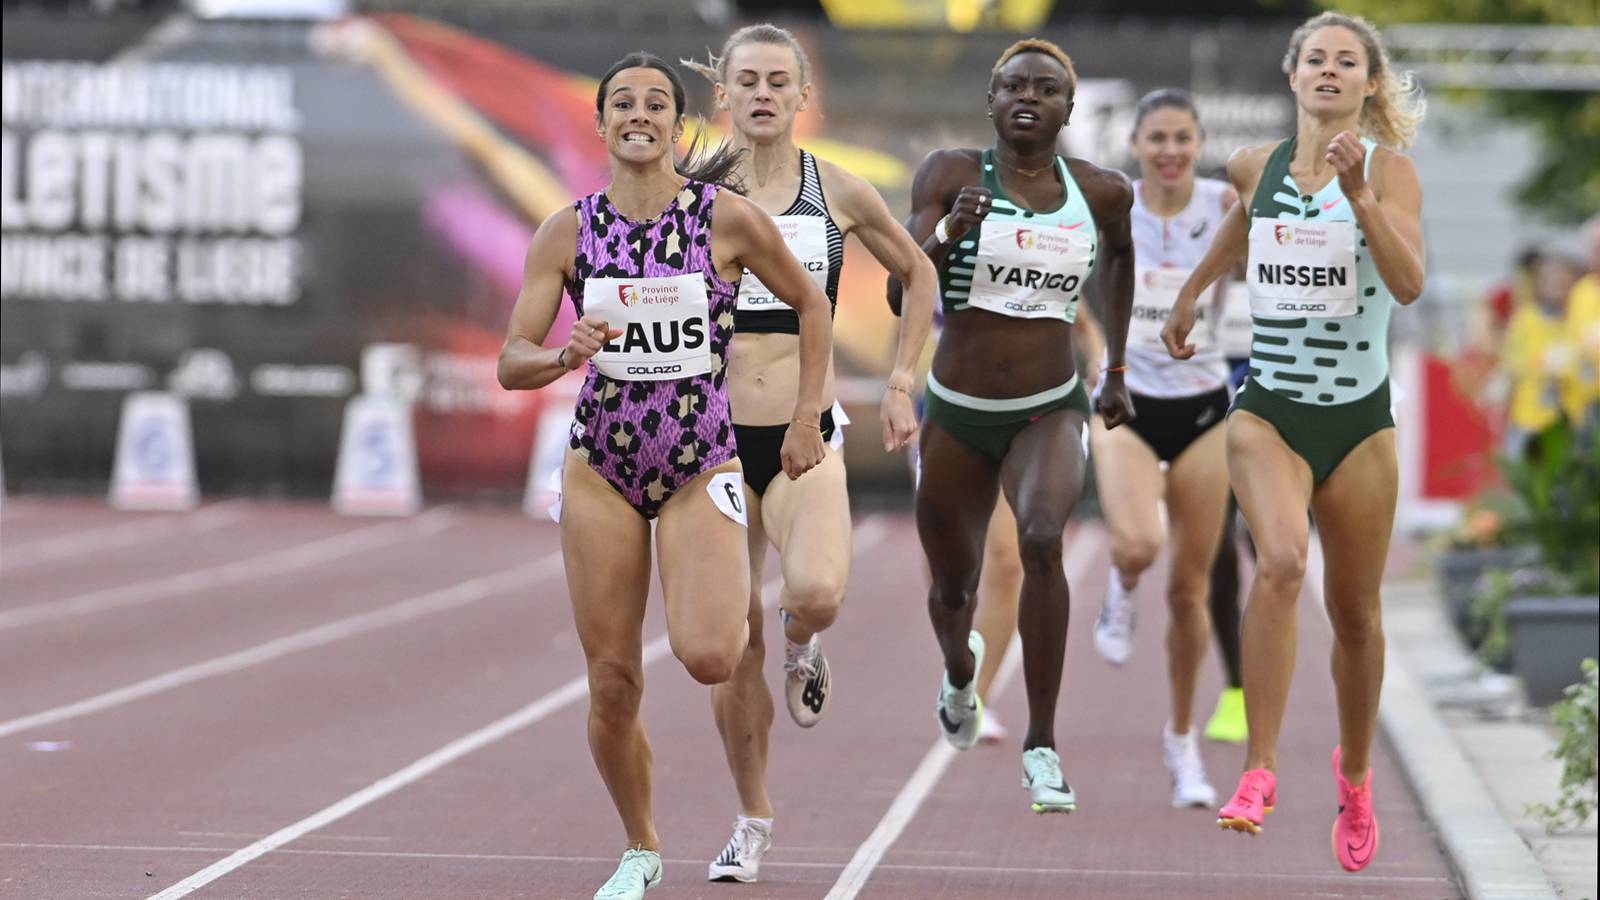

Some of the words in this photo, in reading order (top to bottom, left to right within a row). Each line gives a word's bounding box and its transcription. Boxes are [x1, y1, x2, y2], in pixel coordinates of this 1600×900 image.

[1295, 228, 1327, 237] Province
[1294, 238, 1304, 246] de
[987, 264, 1080, 292] YARIGO
[1258, 263, 1347, 287] NISSEN
[641, 285, 679, 295] Province
[642, 295, 654, 305] de
[655, 294, 680, 306] Liège
[1276, 303, 1327, 312] GOLAZO
[627, 364, 682, 375] GOLAZO
[723, 482, 743, 514] 6
